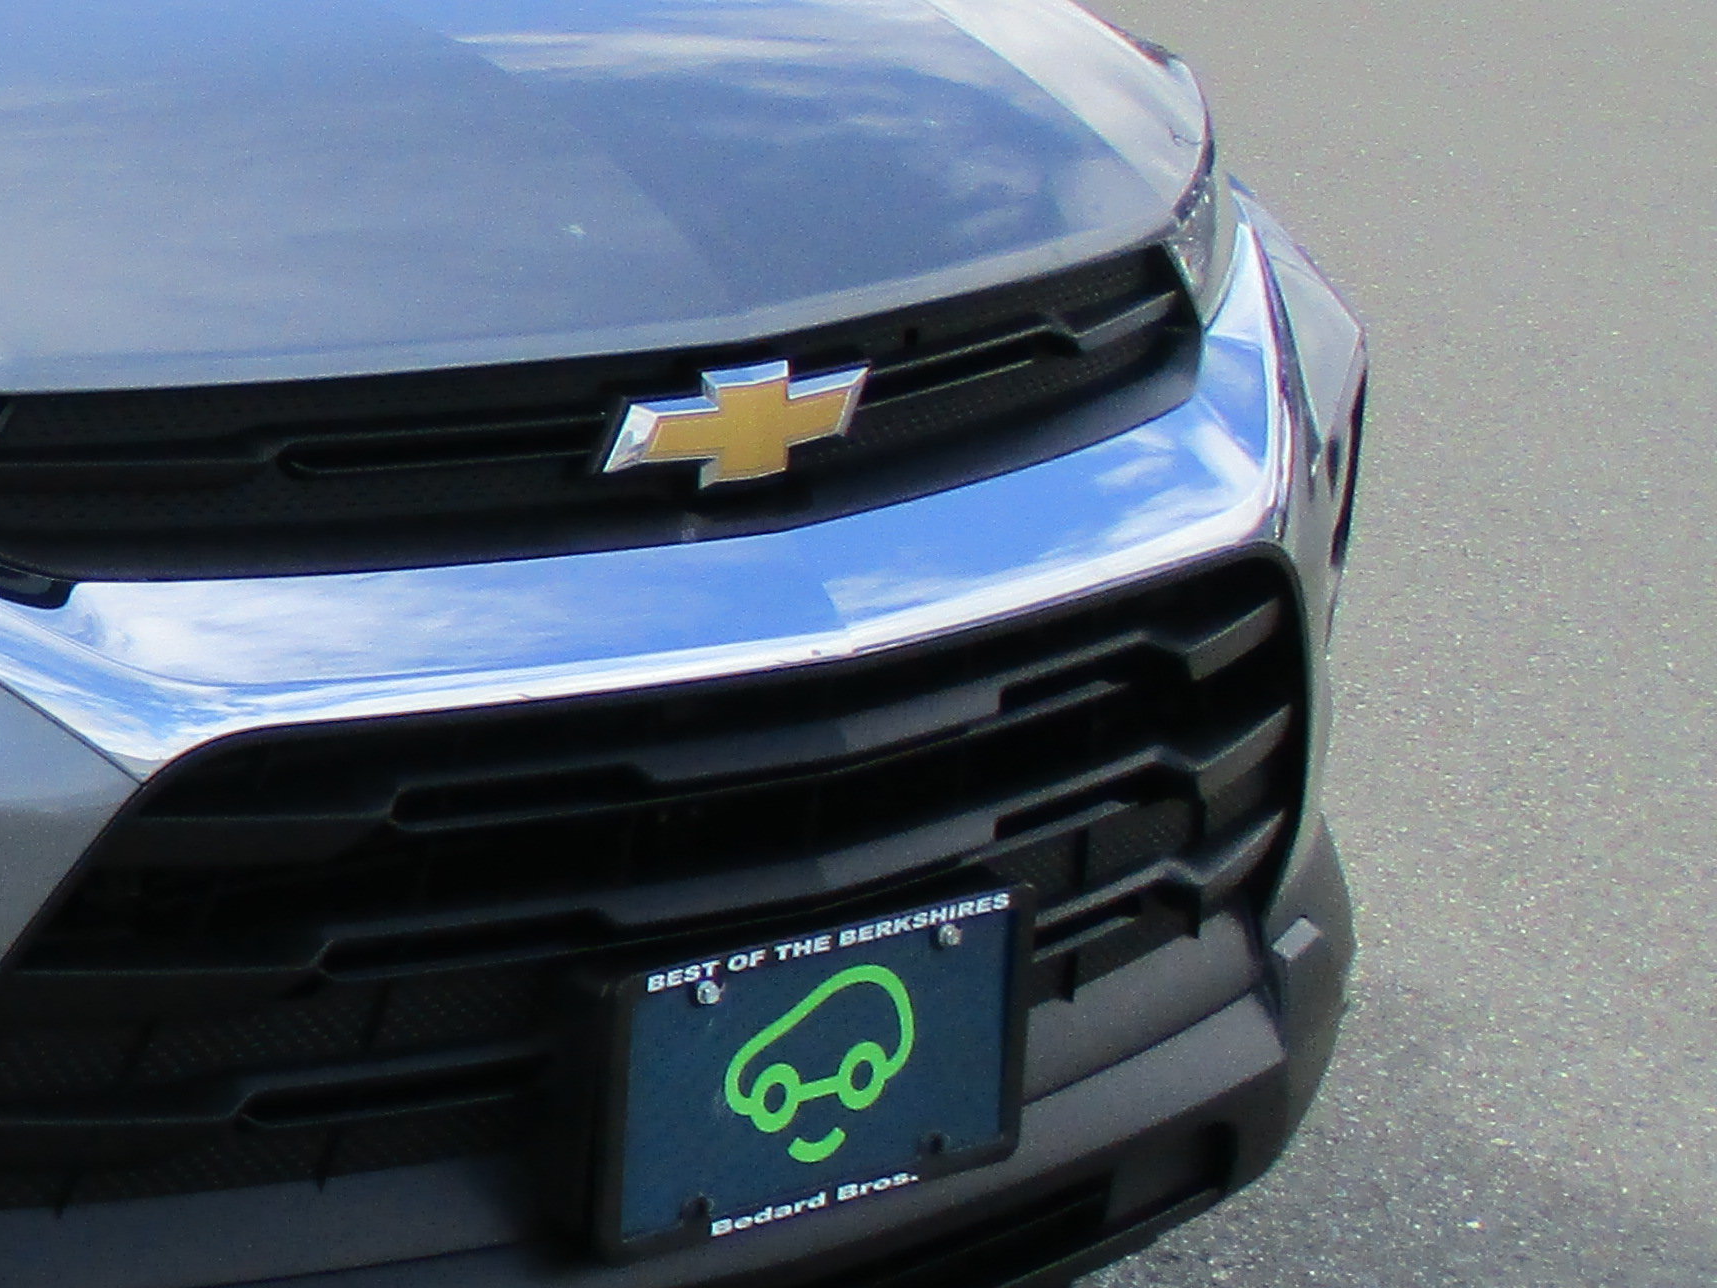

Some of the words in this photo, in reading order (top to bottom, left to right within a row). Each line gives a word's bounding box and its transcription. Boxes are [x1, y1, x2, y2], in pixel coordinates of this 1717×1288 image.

[646, 960, 720, 993] BEST
[726, 949, 766, 972] OF
[774, 934, 831, 961] THE
[838, 892, 1011, 948] BERKSHIRES
[710, 1191, 827, 1237] Bedard
[837, 1172, 919, 1201] Bros.
